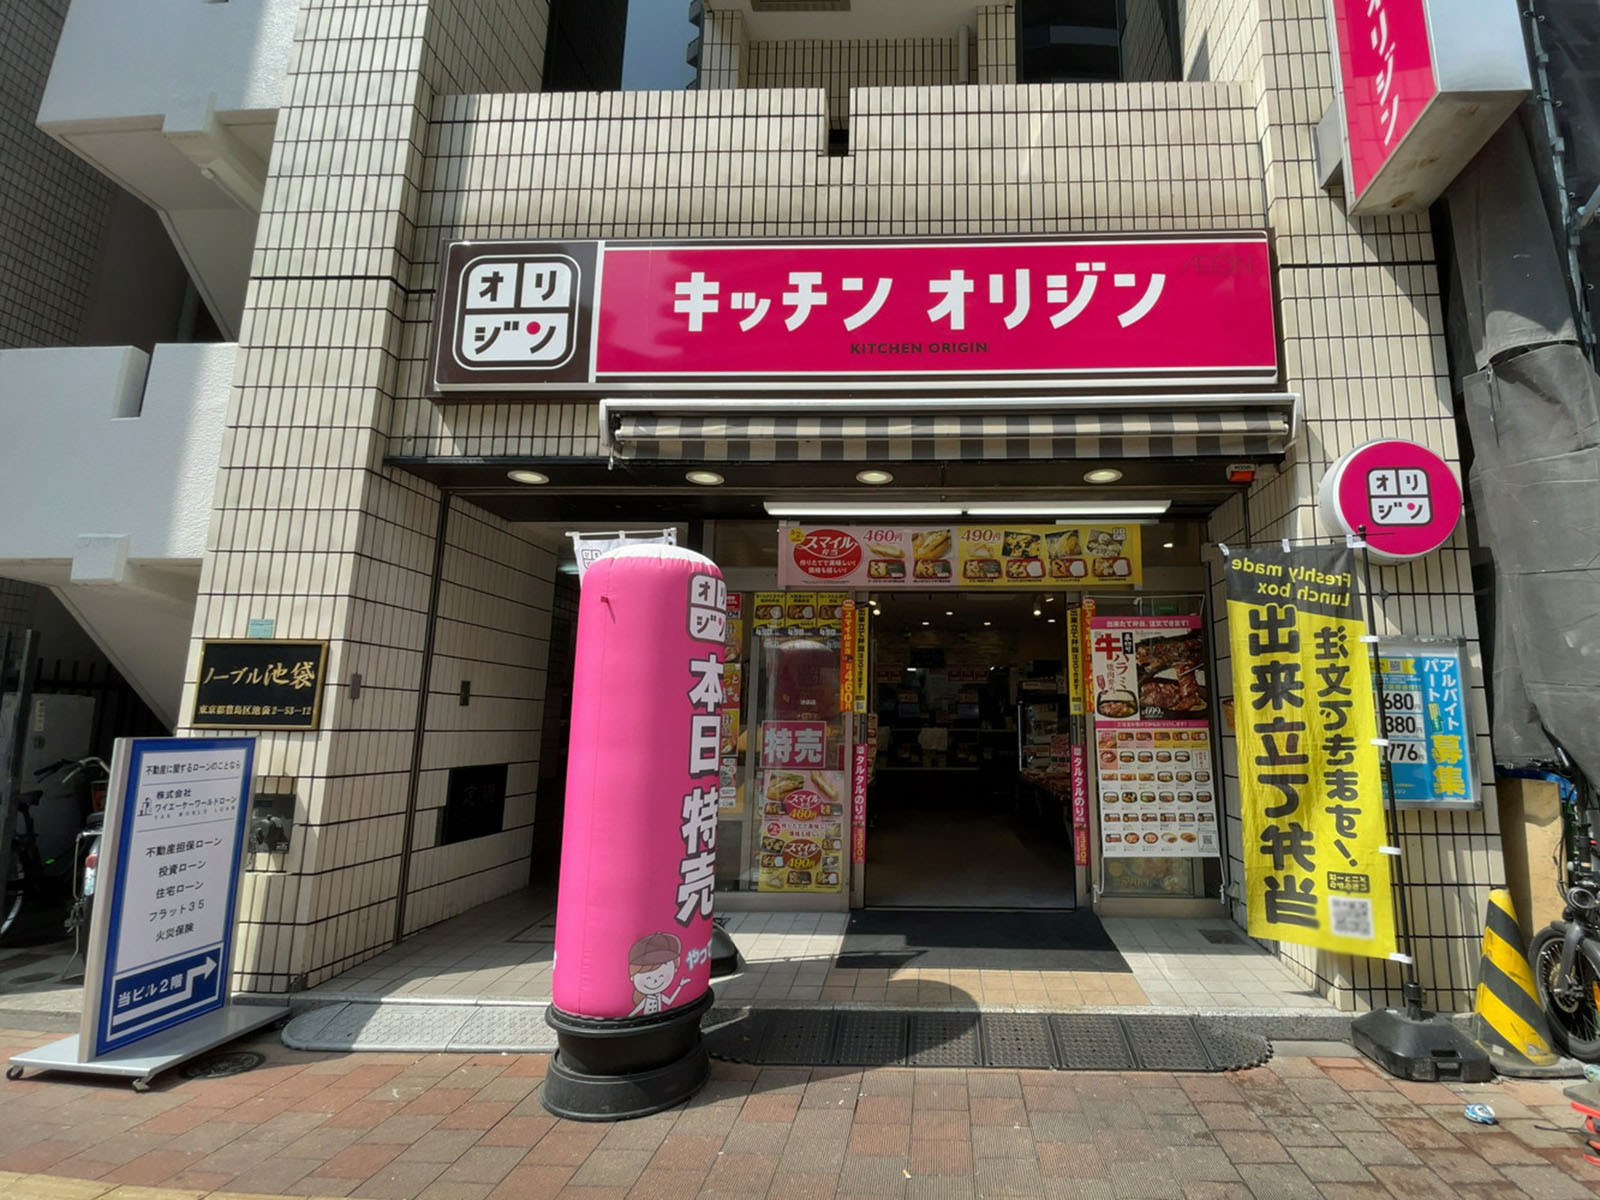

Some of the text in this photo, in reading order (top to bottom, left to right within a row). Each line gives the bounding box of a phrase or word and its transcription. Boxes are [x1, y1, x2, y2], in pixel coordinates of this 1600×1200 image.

[673, 262, 1167, 332] キッチン オリジン
[850, 342, 988, 355] KITCHEN ORIGIN
[805, 536, 854, 549] スマイル
[1094, 633, 1123, 660] 牛
[203, 661, 315, 690] ノーブル池袋
[1113, 653, 1130, 689] ハラミ
[1423, 659, 1441, 702] パート
[1439, 659, 1460, 731] アルバイト
[764, 727, 823, 764] 特売
[1430, 734, 1466, 796] 募集
[156, 788, 192, 800] 株式会社
[676, 653, 724, 924] 本日特売
[145, 837, 223, 858] 不動産担保ローン
[158, 860, 207, 878] 投資ローン
[155, 880, 204, 899] 住宅ローン
[155, 922, 195, 943] 火災保険
[117, 973, 184, 1009] 当ビル2階
